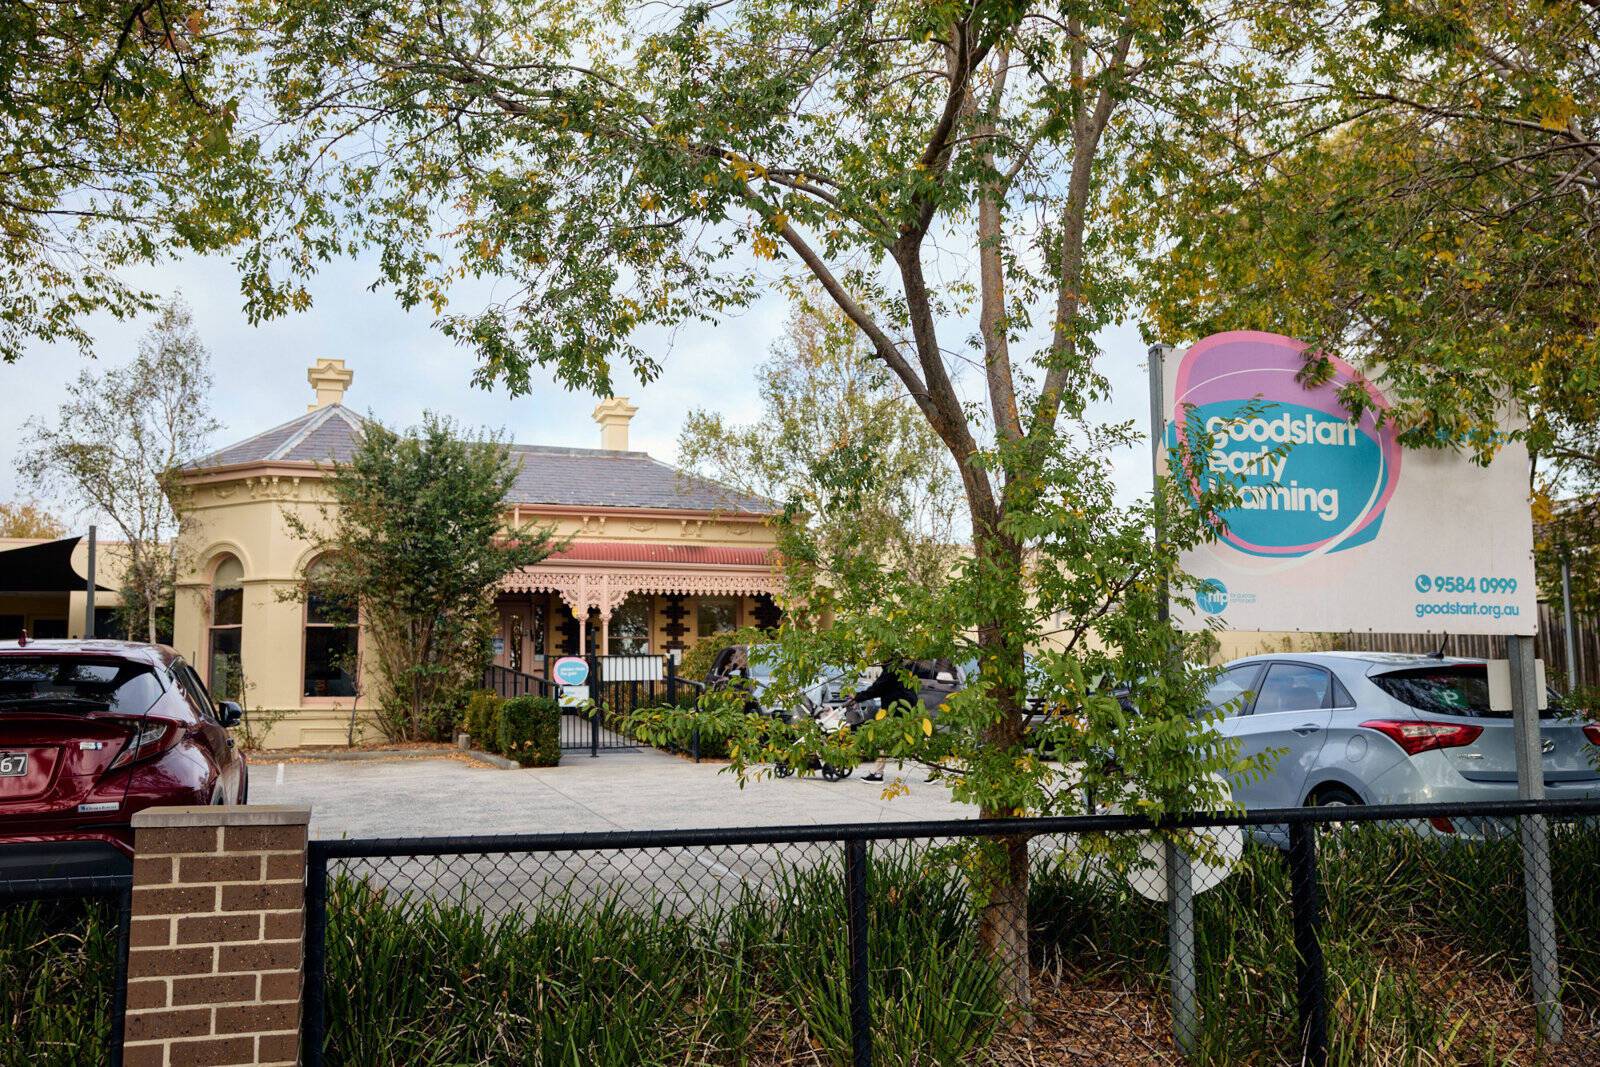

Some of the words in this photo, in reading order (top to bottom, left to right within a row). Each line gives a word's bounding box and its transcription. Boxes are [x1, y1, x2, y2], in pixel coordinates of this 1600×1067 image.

[1206, 413, 1358, 449] goodstart
[1208, 446, 1288, 483] early
[1208, 478, 1339, 521] larning
[1434, 576, 1476, 593] 9584
[1480, 577, 1517, 594] 0999
[1415, 602, 1519, 619] goodstart.org.au
[0, 756, 26, 773] 67
